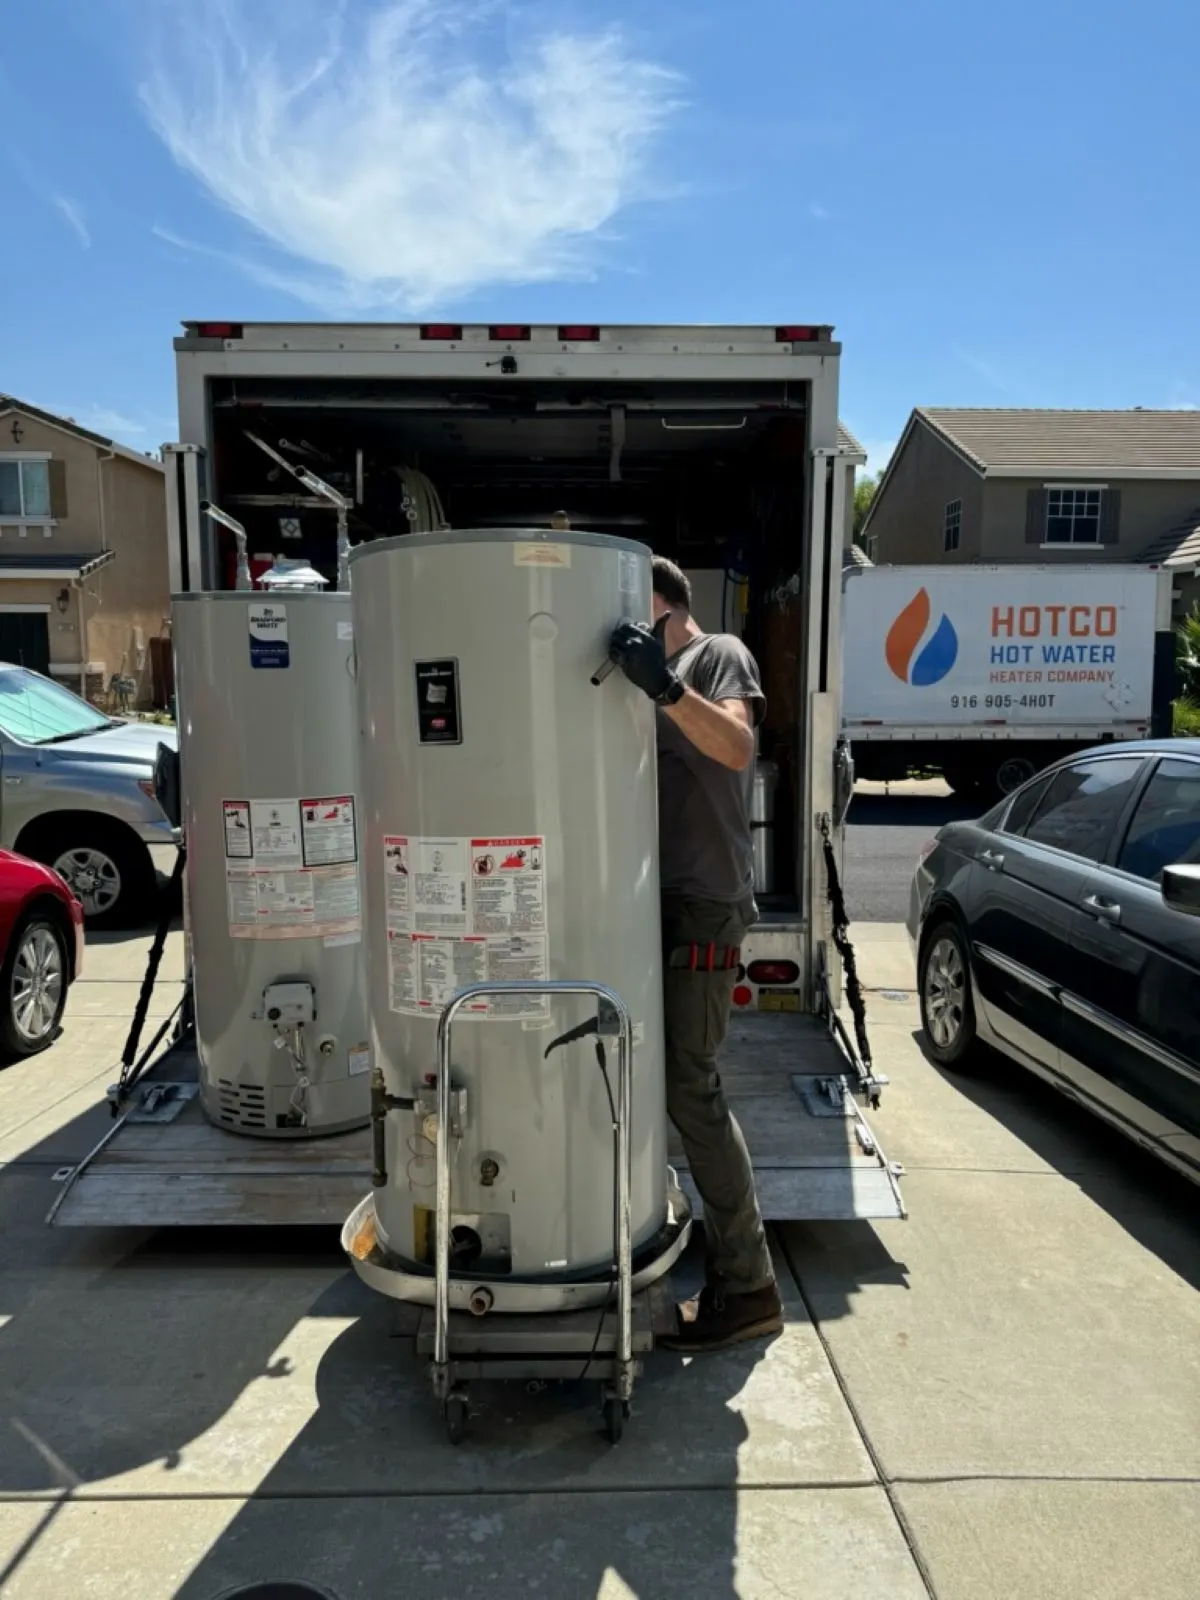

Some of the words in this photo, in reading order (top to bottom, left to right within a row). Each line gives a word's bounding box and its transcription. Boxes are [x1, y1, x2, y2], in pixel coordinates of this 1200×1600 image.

[992, 606, 1117, 637] HOTCO
[990, 645, 1034, 664] HOT
[1042, 645, 1115, 664] WATER
[989, 670, 1042, 683] HEATER
[1047, 670, 1115, 683] COMPANY
[950, 694, 978, 708] 916
[984, 694, 1056, 708] 905-4HOT
